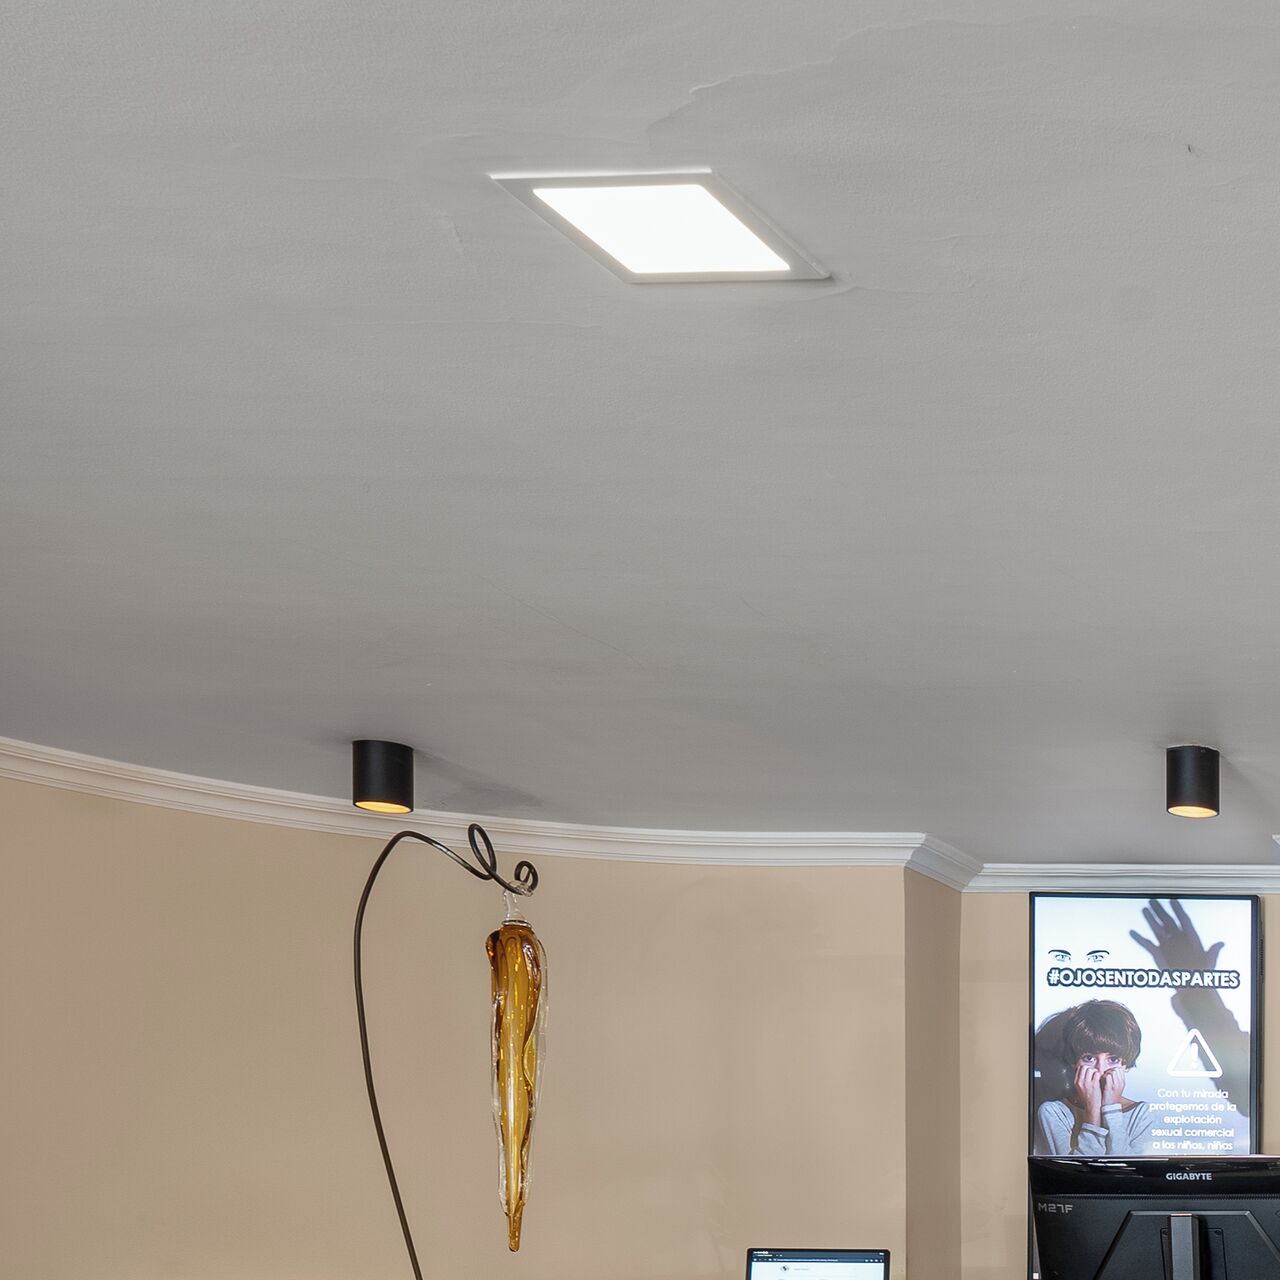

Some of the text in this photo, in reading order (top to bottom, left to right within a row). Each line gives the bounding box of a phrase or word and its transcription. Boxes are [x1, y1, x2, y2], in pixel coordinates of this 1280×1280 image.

[1048, 969, 1240, 988] #OJOSENTODASPARTES
[1157, 1088, 1229, 1098] Con tu mirada
[1149, 1102, 1237, 1112] protegemos de la
[1163, 1115, 1222, 1125] explotación
[1151, 1128, 1234, 1137] sexual comercial
[1162, 1140, 1175, 1149] los
[1177, 1140, 1206, 1150] niños,
[1207, 1141, 1233, 1150] niñas
[1165, 1172, 1212, 1181] GIGABYTE
[1037, 1202, 1073, 1214] M27F
